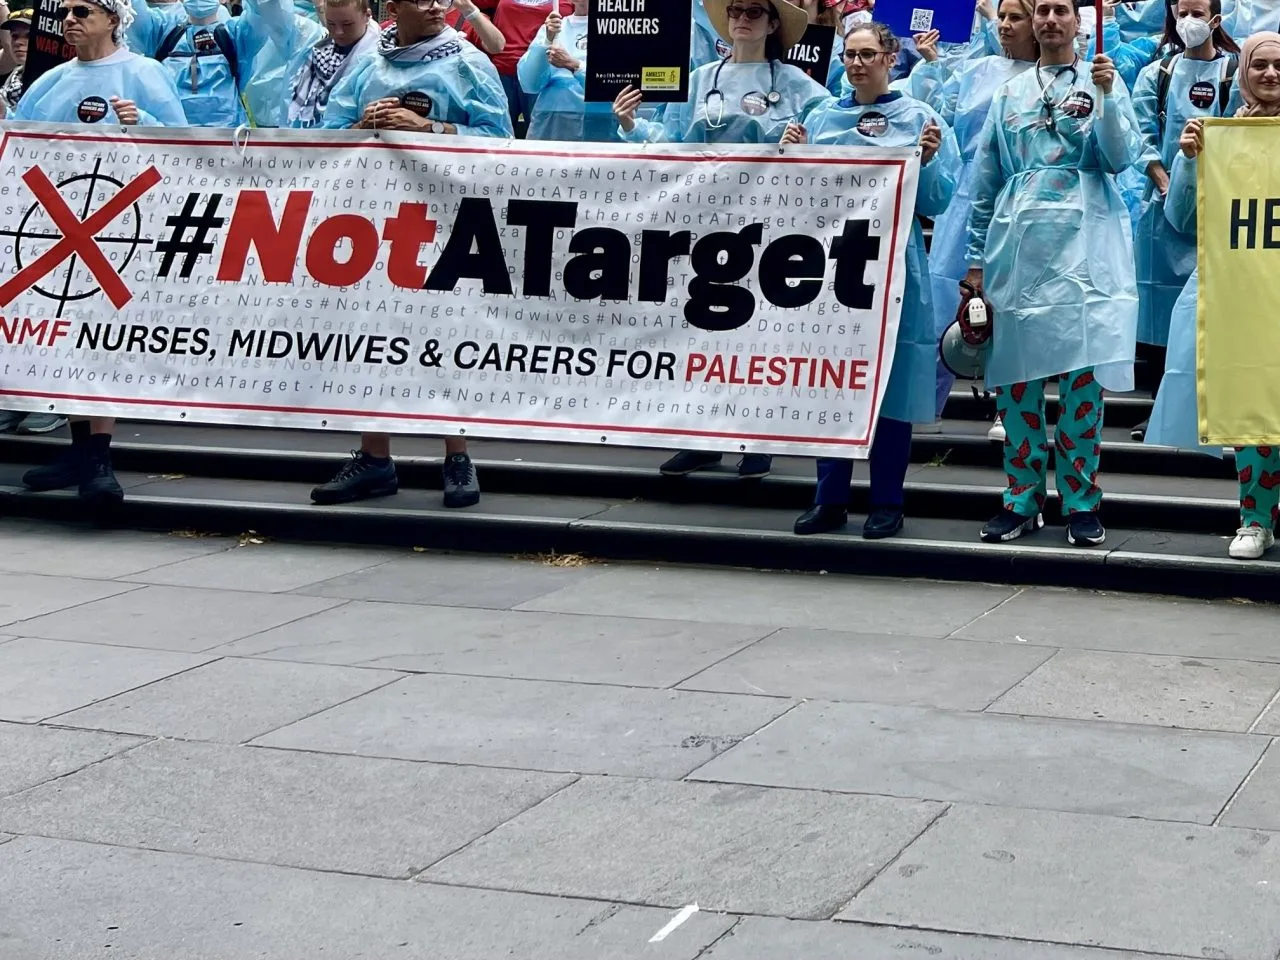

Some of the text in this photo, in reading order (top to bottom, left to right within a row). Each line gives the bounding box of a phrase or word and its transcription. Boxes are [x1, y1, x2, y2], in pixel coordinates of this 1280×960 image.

[597, 18, 659, 35] WORKERS
[242, 156, 718, 187] Midwives#NotATarget Carers#NotATarget
[155, 190, 880, 331] #NotATarget
[76, 322, 869, 390] NURSES, MIDWIVES & CARERS FOR PALESTINE
[26, 363, 854, 425] AidWorkers#NotATarget Hospitals#NotATarget Patients#NotaTarget
